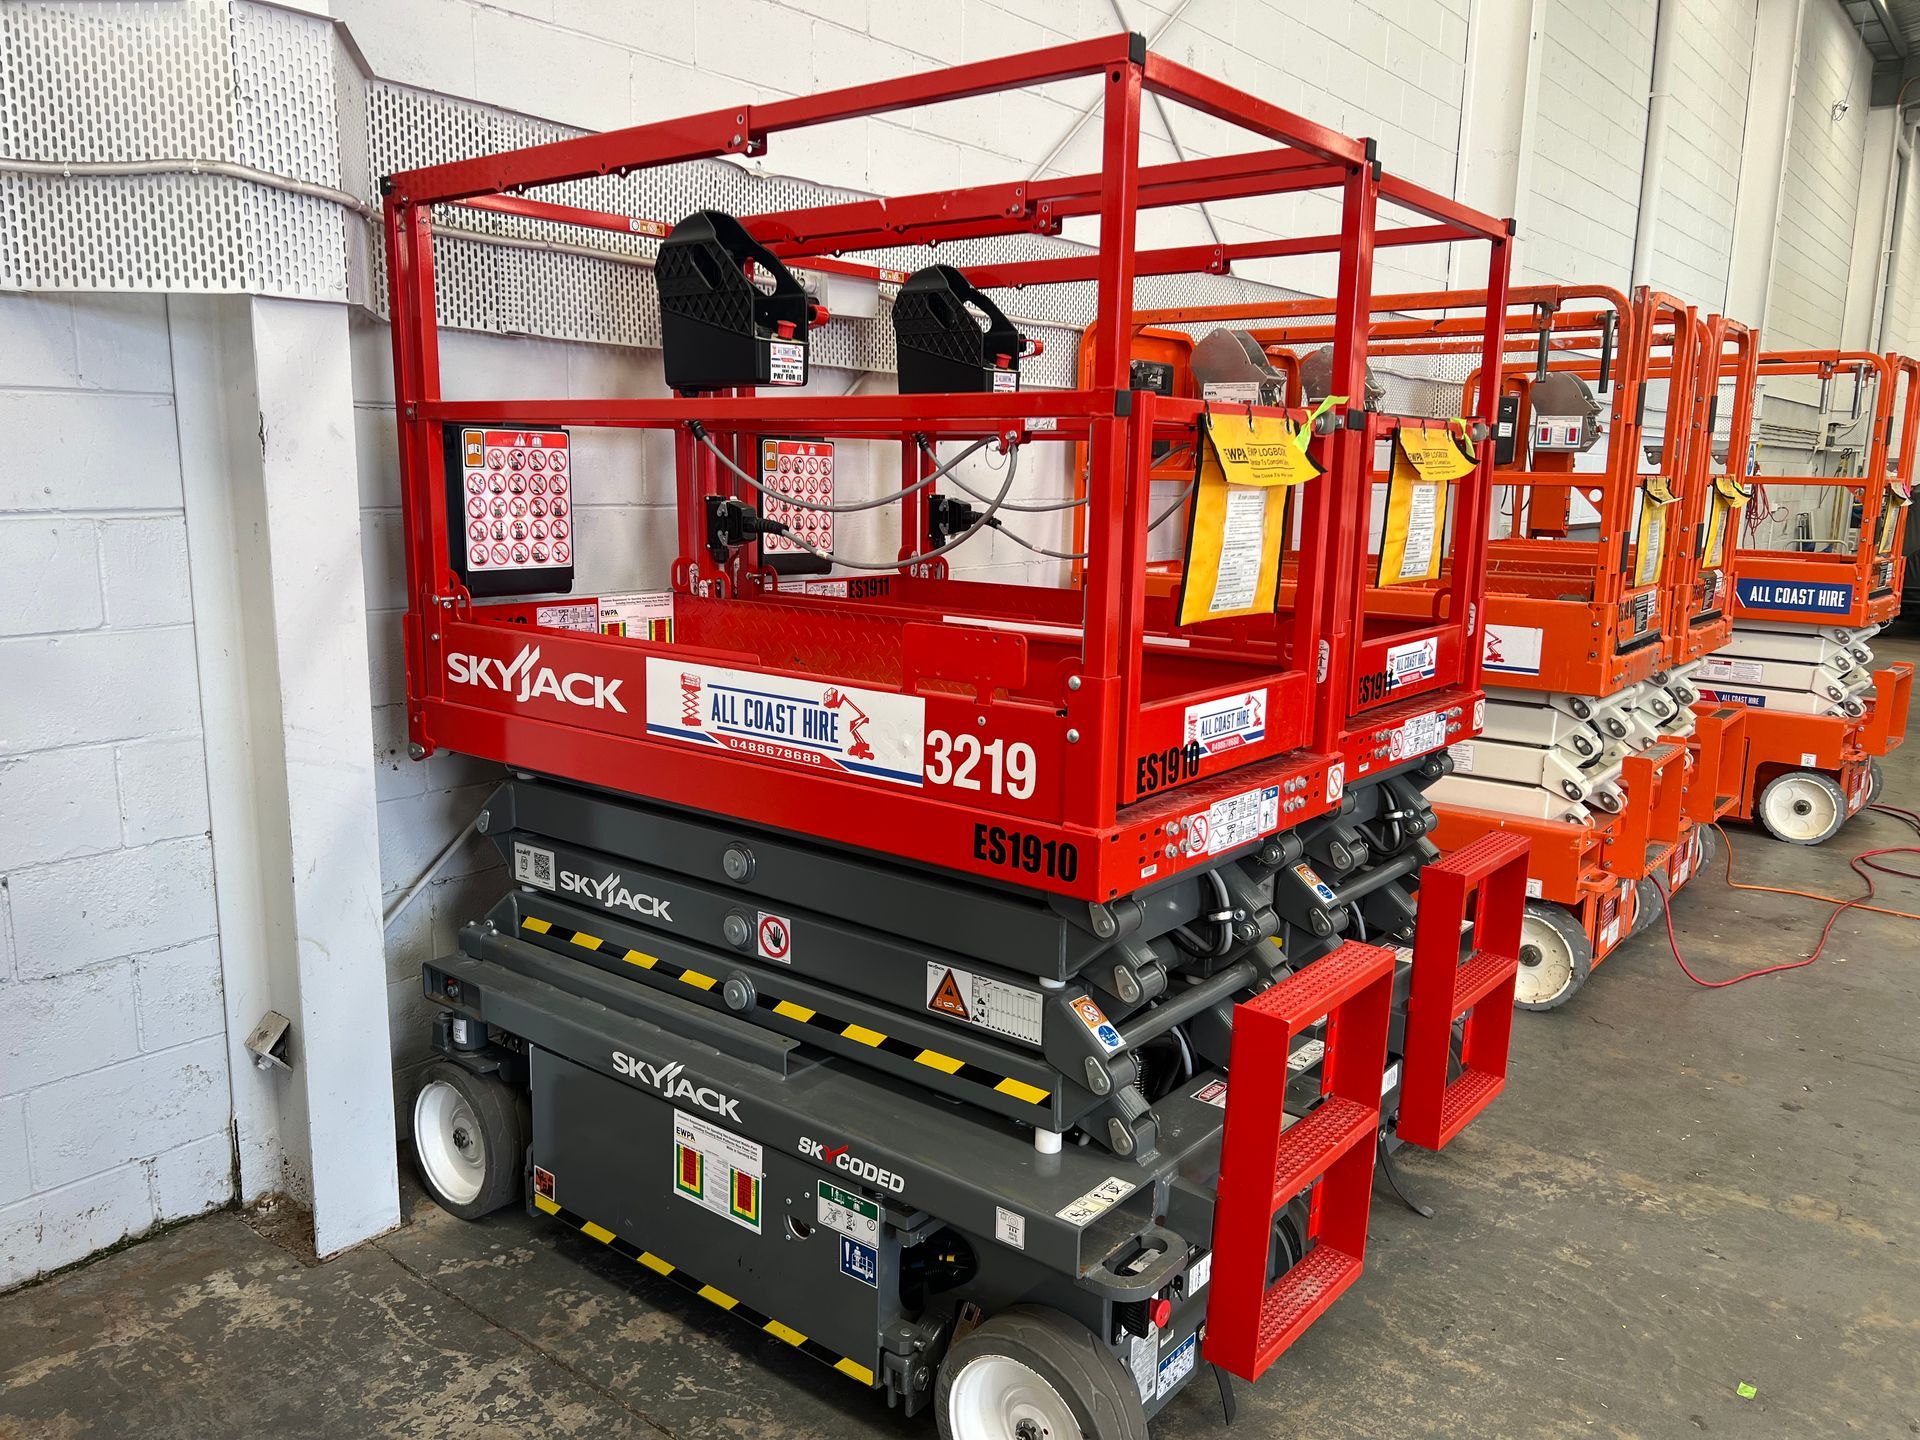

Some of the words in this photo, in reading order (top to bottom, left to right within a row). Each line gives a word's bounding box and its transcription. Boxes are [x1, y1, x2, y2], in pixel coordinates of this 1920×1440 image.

[849, 578, 890, 598] ES1911
[1750, 586, 1770, 602] ALL
[1775, 587, 1815, 605] COAST
[1818, 590, 1846, 607] HIRE
[447, 643, 628, 713] SKYJACK
[1358, 669, 1393, 704] ES1911
[1722, 694, 1730, 702] ALL
[1731, 694, 1747, 703] COAST
[711, 693, 738, 725] ALL
[744, 698, 796, 736] COAST
[802, 707, 839, 744] HIRE
[1200, 719, 1212, 737] ALL
[1214, 712, 1235, 733] COAST
[1236, 709, 1250, 726] HIRE
[730, 738, 821, 764] 0488678688
[925, 729, 1036, 800] 3219
[1137, 740, 1200, 794] ES1910
[974, 823, 1078, 882] ES1910
[560, 870, 673, 922] SKYJACK
[612, 1051, 742, 1123] SKYJACK
[676, 1126, 695, 1141] EWPA
[798, 1136, 905, 1193] SKYCODED
